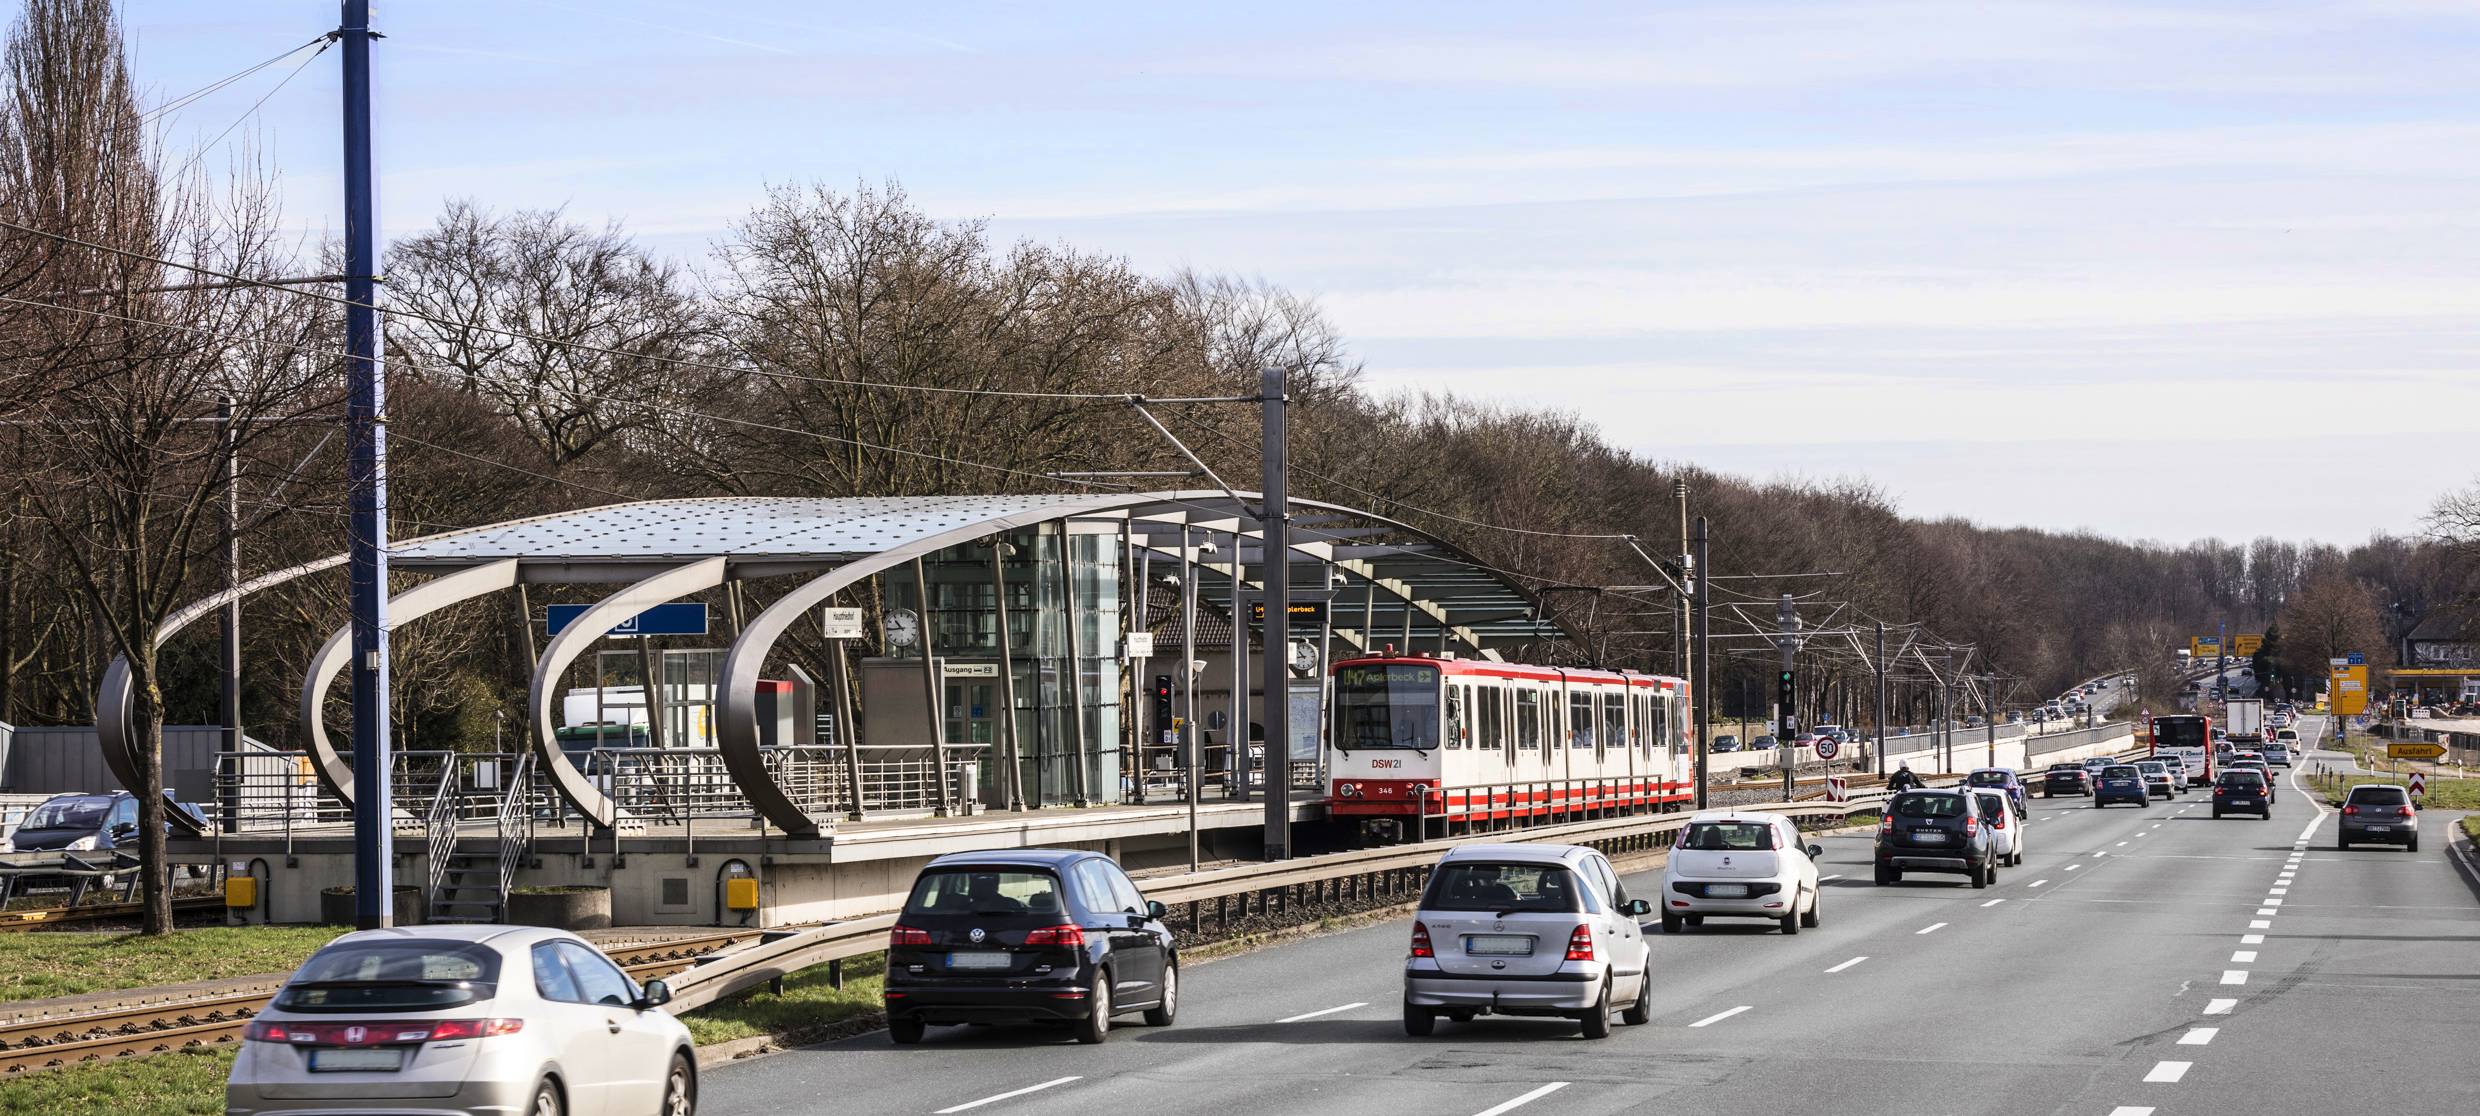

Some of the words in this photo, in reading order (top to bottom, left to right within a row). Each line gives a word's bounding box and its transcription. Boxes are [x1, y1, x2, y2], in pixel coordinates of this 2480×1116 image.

[944, 666, 973, 674] Ausgang
[1344, 669, 1366, 686] U47
[1366, 672, 1415, 682] Aplerbeck
[1820, 743, 1834, 754] 50
[2397, 747, 2432, 755] Ausfahrt
[1371, 759, 1402, 769] DSW21
